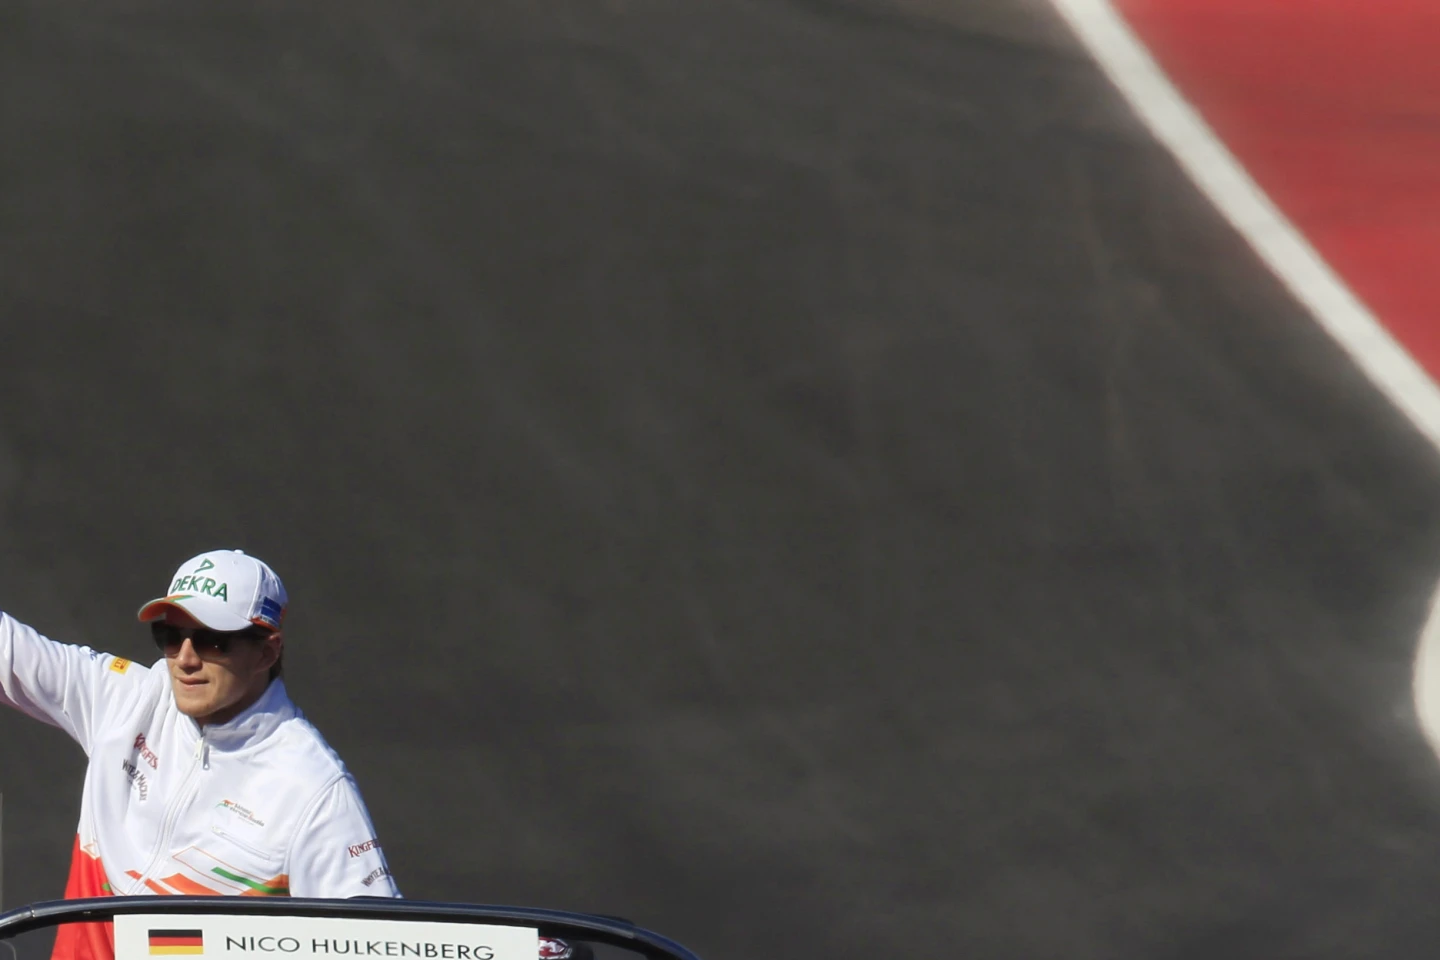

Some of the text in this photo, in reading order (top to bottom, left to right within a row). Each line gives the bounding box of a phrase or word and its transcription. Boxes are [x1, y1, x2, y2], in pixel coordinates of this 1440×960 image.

[170, 575, 228, 602] DEKRA
[226, 936, 495, 960] NICO HULKENBERG
